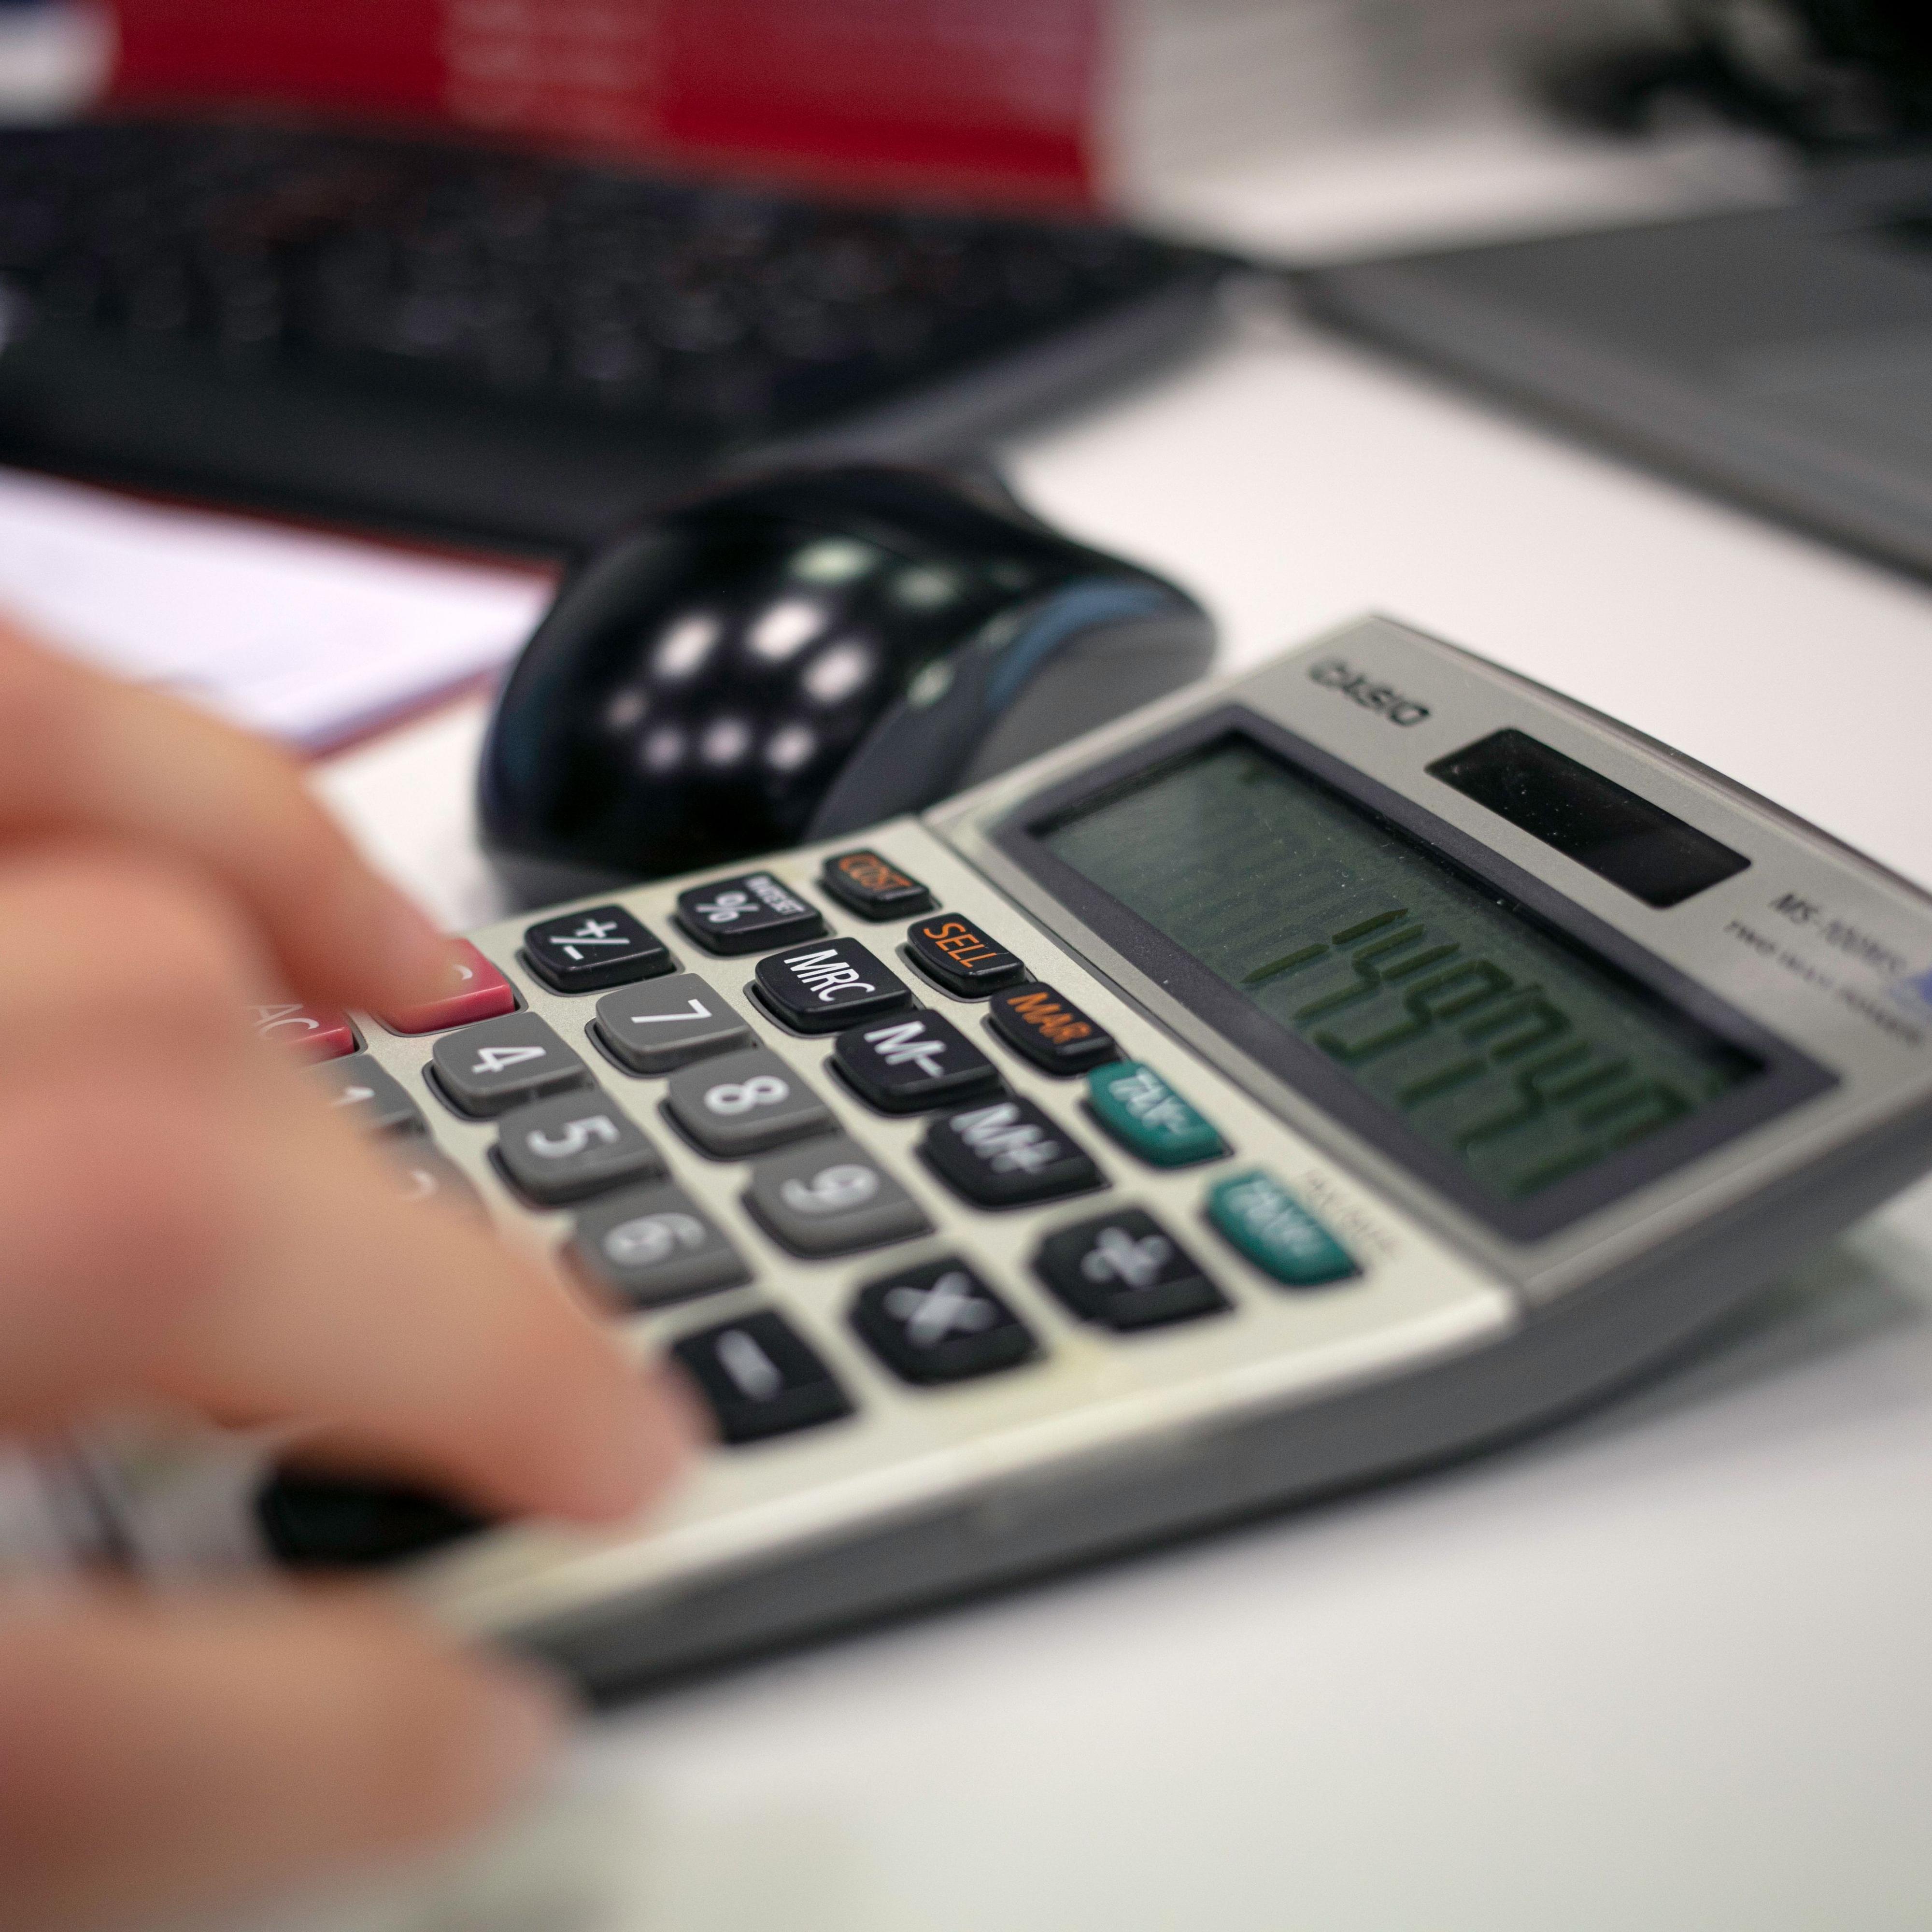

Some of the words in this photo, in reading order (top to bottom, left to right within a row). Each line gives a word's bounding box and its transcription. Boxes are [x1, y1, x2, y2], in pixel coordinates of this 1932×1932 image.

[1308, 659, 1430, 727] CASIO
[696, 891, 760, 922] %
[923, 923, 998, 968] SELL
[784, 949, 875, 1001] MRC
[631, 998, 712, 1023] 7
[1007, 992, 1093, 1045] MAR
[472, 1046, 546, 1074] 4
[864, 1021, 947, 1078] M-
[703, 1075, 790, 1116] 8
[527, 1115, 620, 1157] 5
[949, 1102, 1062, 1175] M+
[781, 1164, 878, 1213] 9
[603, 1211, 707, 1267] 6
